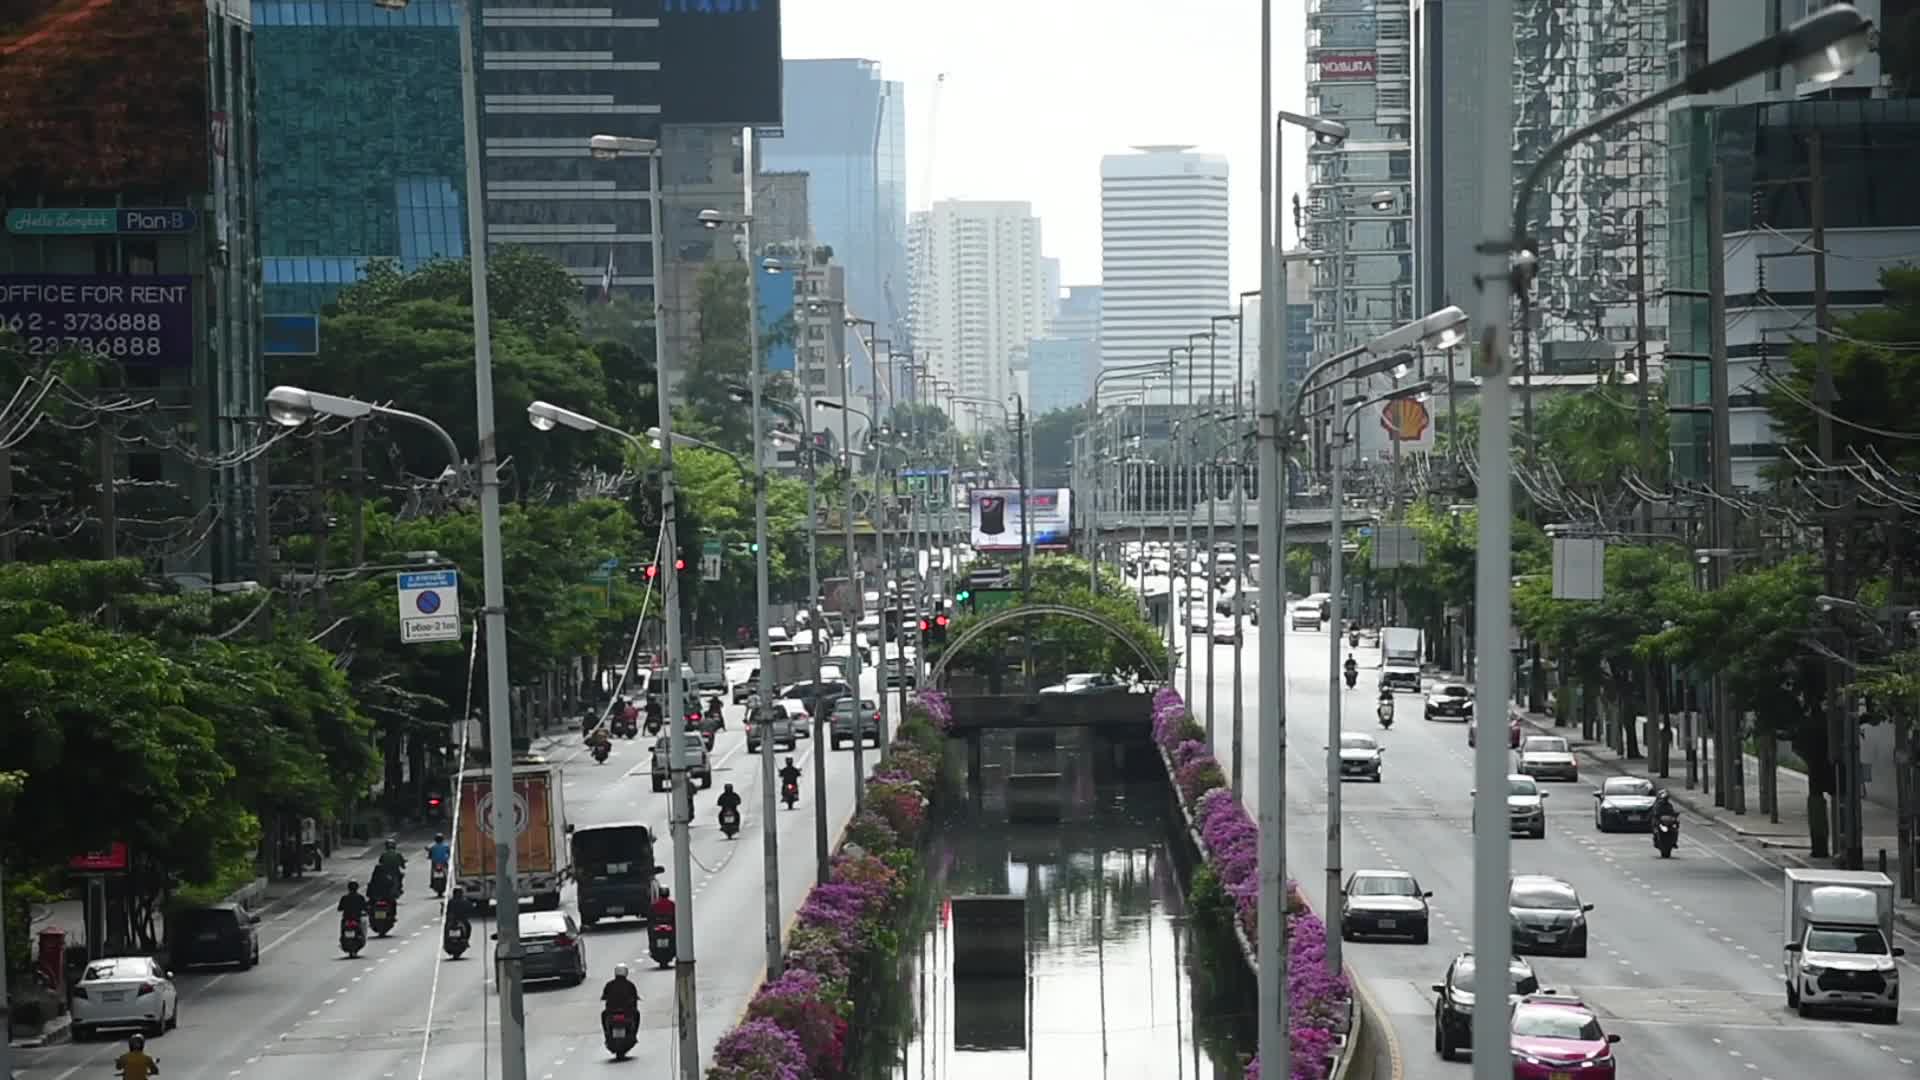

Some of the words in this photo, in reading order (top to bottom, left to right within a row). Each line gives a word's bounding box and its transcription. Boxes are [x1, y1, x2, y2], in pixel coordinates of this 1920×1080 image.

[0, 285, 75, 303] OFFICE
[81, 286, 123, 304] FOR
[131, 286, 187, 304] RENT
[63, 312, 161, 331] 3736888
